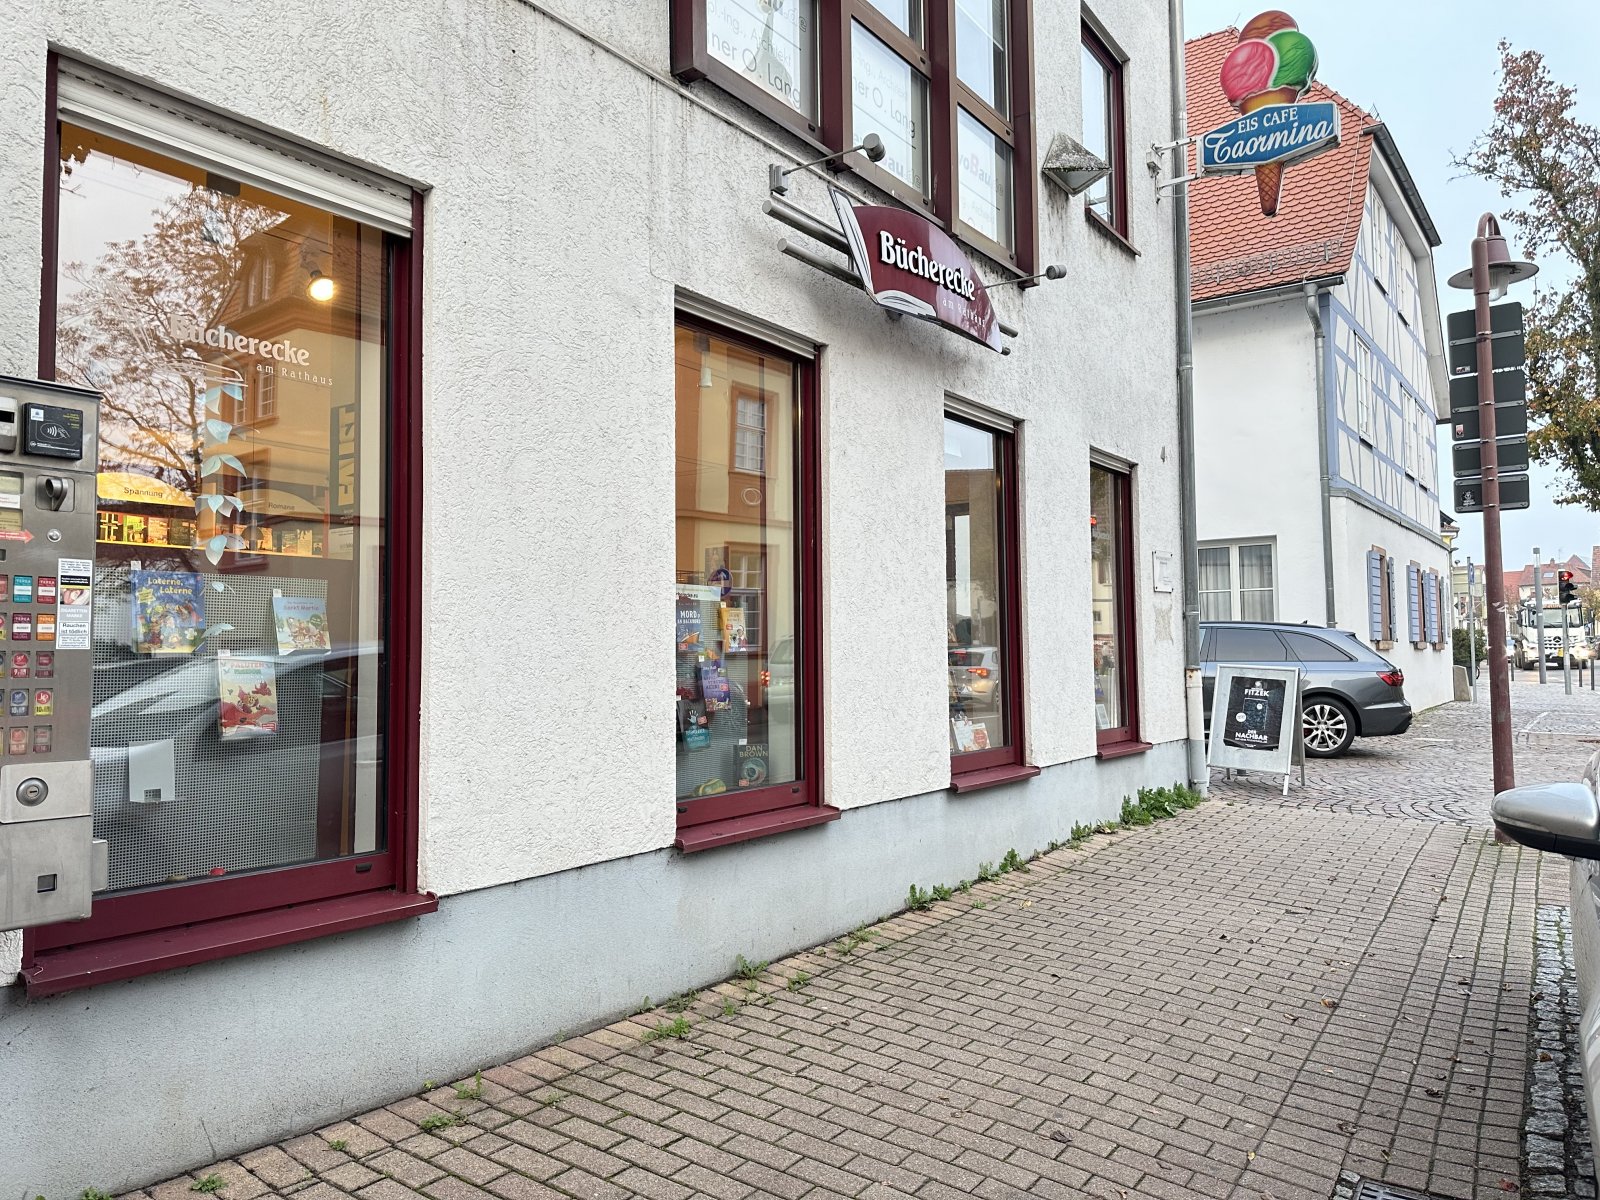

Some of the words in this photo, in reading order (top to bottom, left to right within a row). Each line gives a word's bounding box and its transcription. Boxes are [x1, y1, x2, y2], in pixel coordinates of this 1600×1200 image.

[767, 62, 801, 110] Lang
[890, 98, 916, 139] Lang
[1237, 117, 1258, 134] EIS
[1262, 107, 1298, 127] CAFE
[1205, 120, 1333, 164] Taormina
[879, 230, 976, 301] Bücherecke
[942, 297, 954, 311] am
[256, 363, 274, 374] am
[281, 367, 334, 387] Rathaus
[123, 486, 163, 499] Spannung
[268, 502, 296, 512] Romane
[148, 576, 184, 587] Laterne,
[160, 587, 193, 596] Laterne
[680, 610, 697, 619] MORD
[1244, 688, 1270, 697] FITZEK
[1235, 731, 1268, 740] NACHBAR
[739, 750, 769, 758] BROWN
